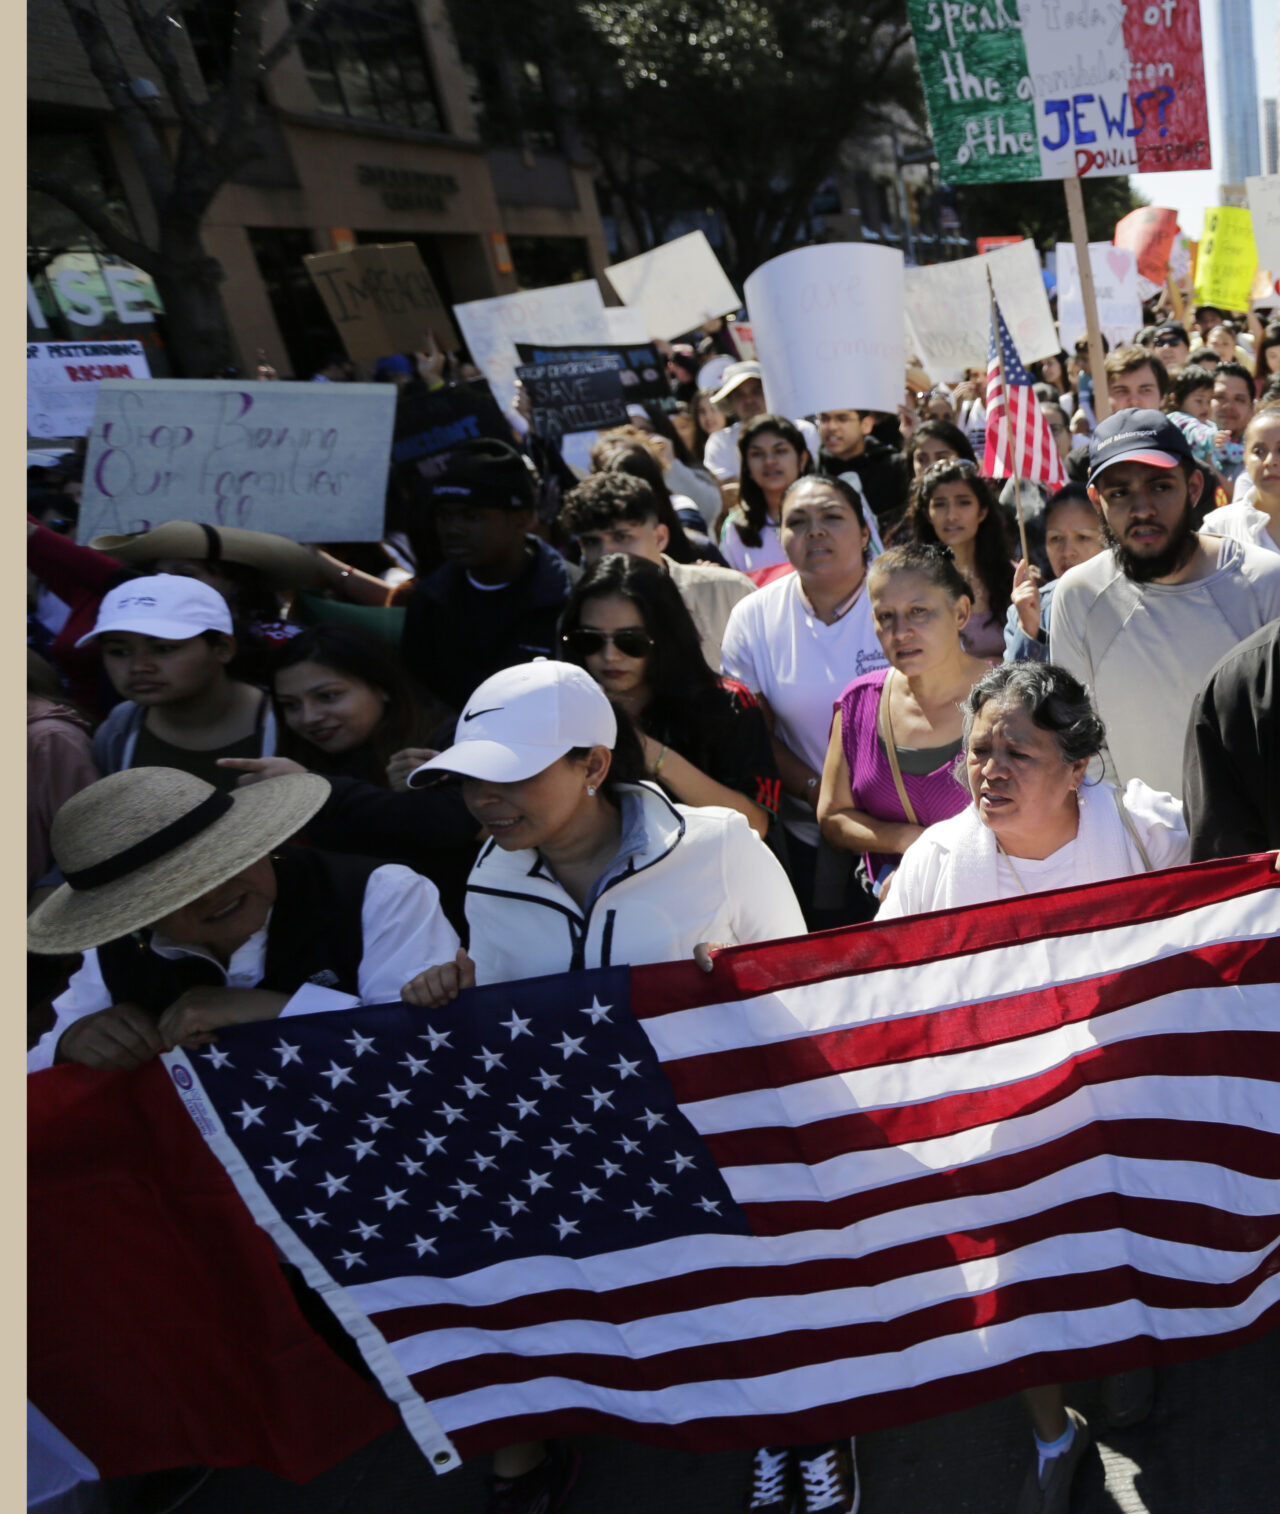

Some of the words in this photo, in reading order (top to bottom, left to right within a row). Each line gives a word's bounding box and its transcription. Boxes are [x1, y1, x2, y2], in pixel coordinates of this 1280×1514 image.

[940, 49, 1001, 103] the
[1075, 146, 1144, 177] DONALD
[534, 376, 593, 403] SAVE
[531, 397, 628, 440] FAMILIES
[1113, 429, 1157, 442] Motorsport
